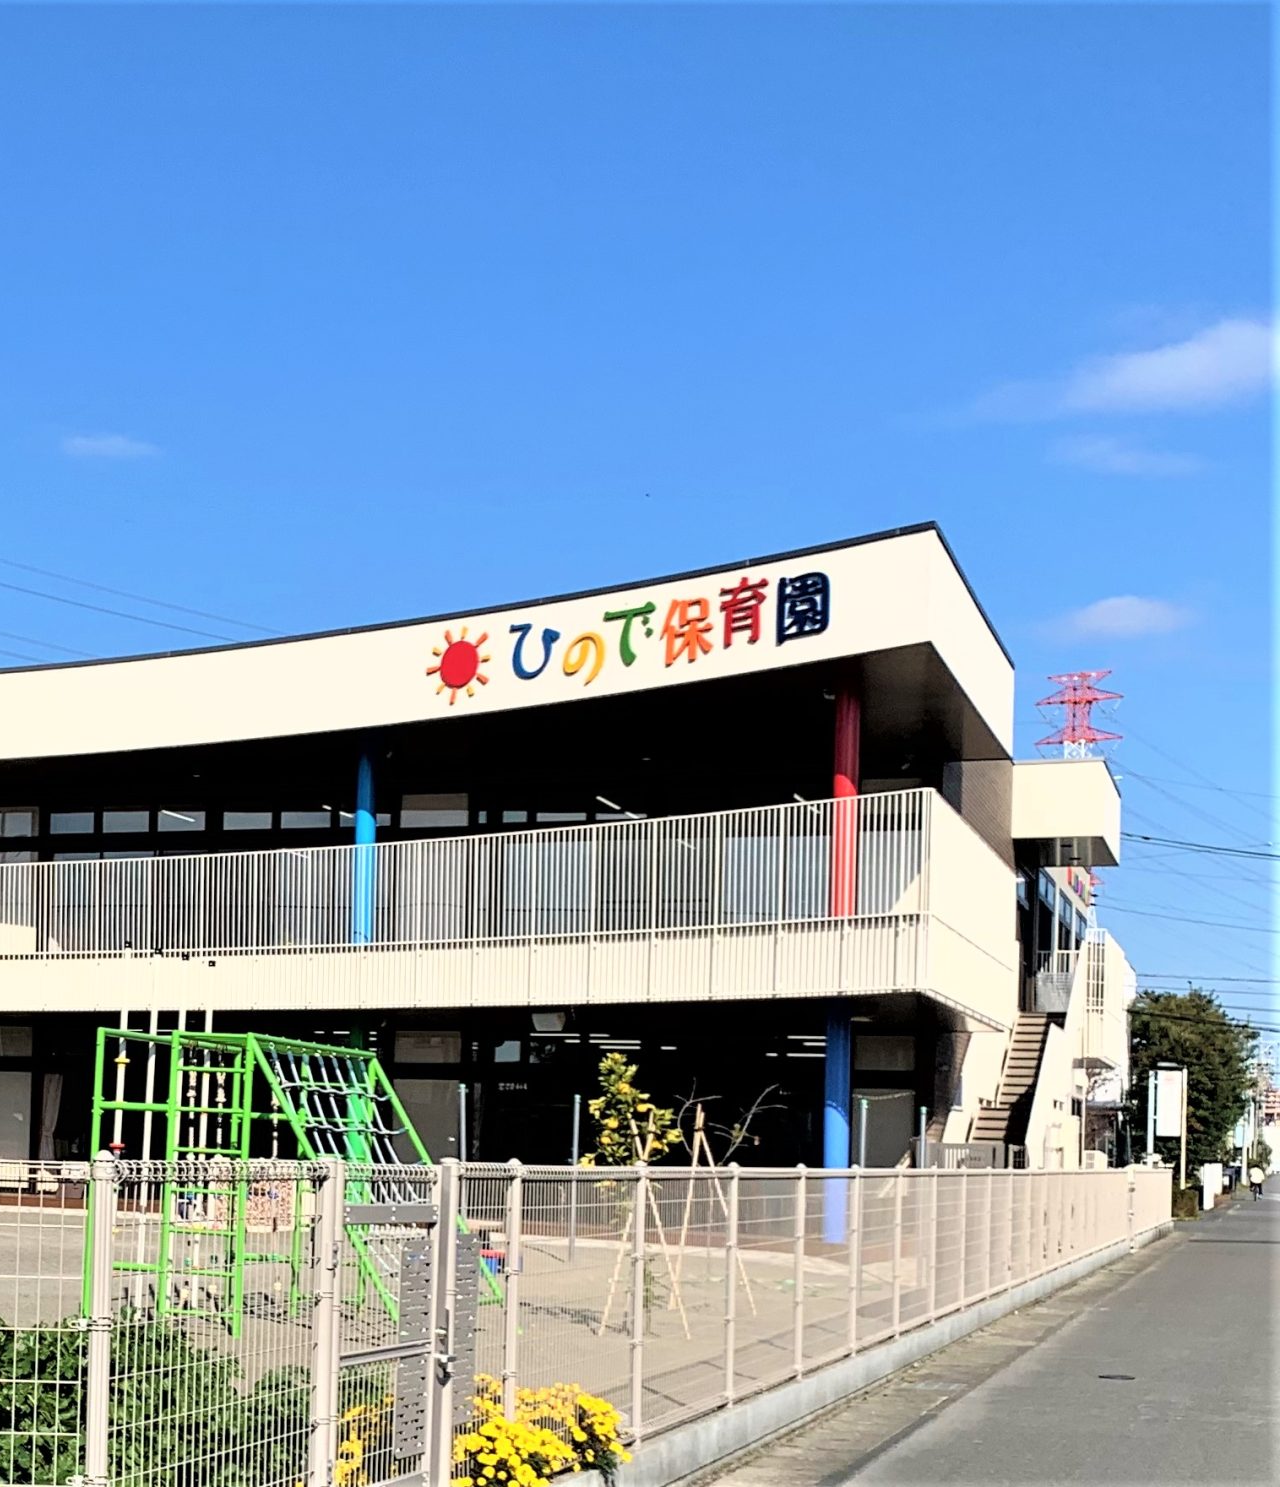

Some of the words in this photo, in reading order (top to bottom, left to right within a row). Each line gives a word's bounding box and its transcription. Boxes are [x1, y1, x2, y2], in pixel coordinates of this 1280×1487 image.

[509, 572, 831, 686] ひので保育園
